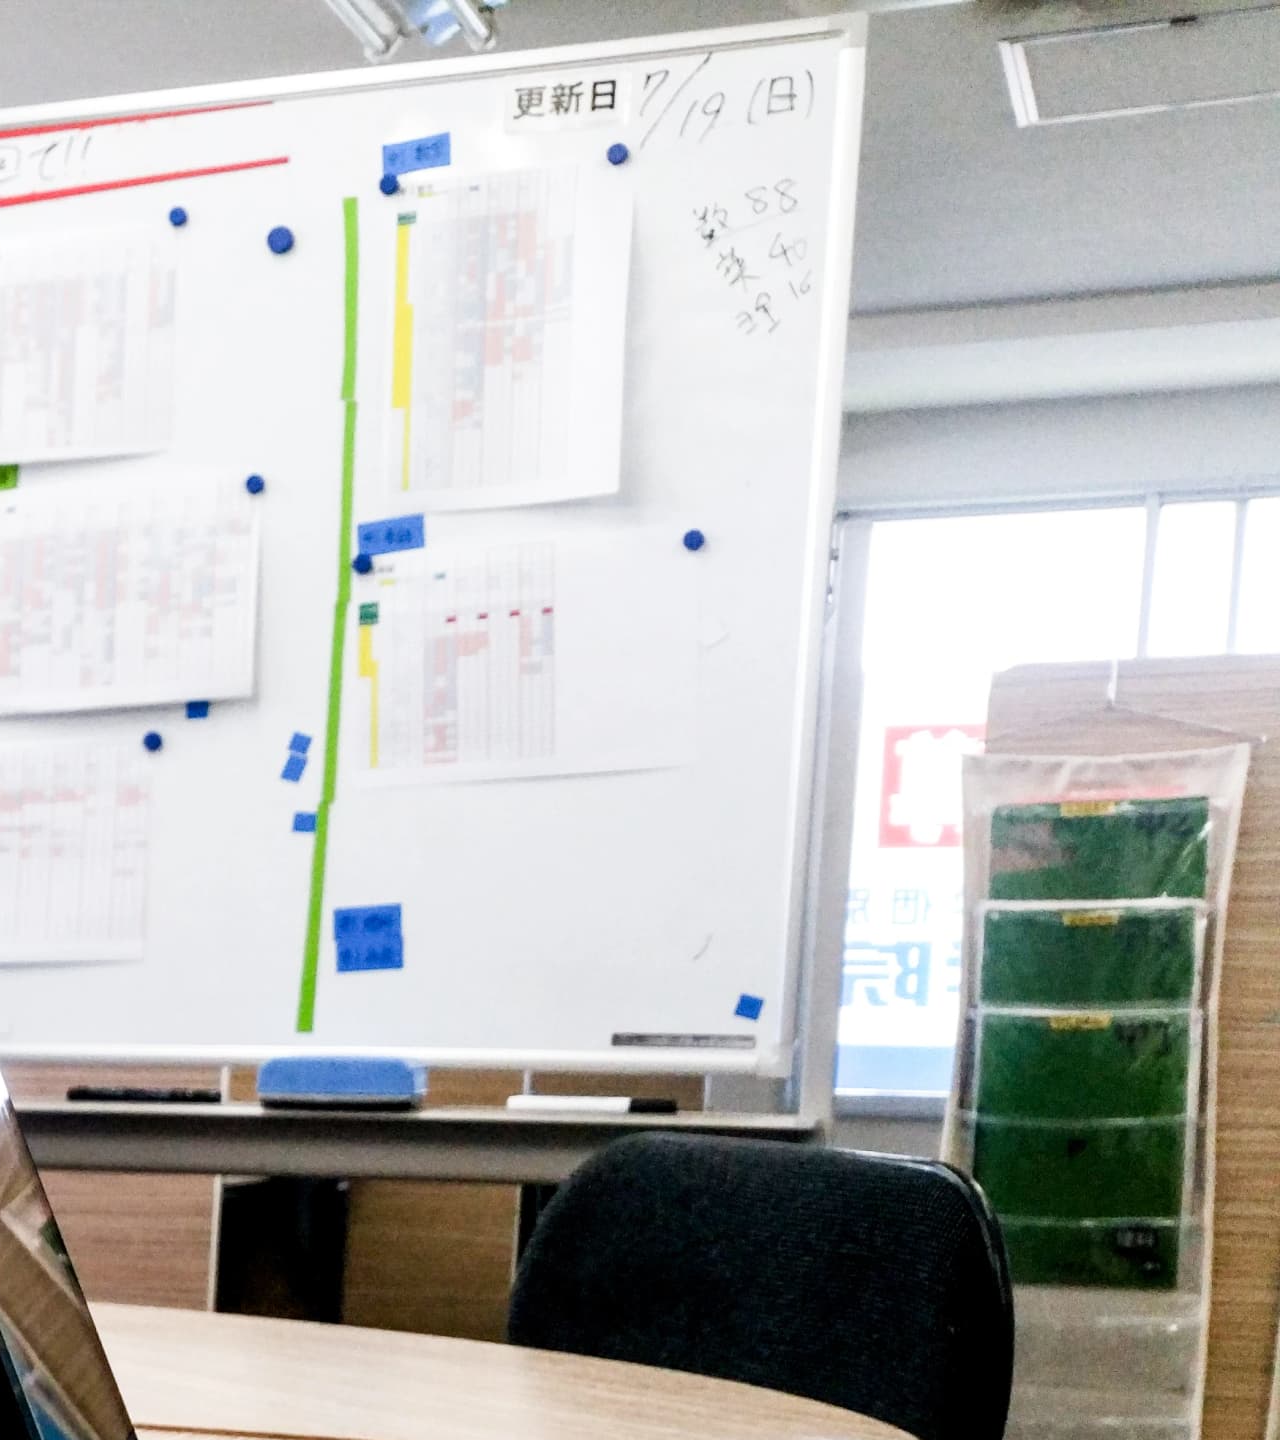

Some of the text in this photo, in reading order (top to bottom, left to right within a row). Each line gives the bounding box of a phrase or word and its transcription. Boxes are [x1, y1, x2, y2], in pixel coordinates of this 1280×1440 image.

[512, 80, 618, 119] 更新日
[638, 50, 728, 150] 7/19
[743, 177, 800, 215] 88
[767, 231, 809, 268] 40
[788, 268, 814, 301] 16
